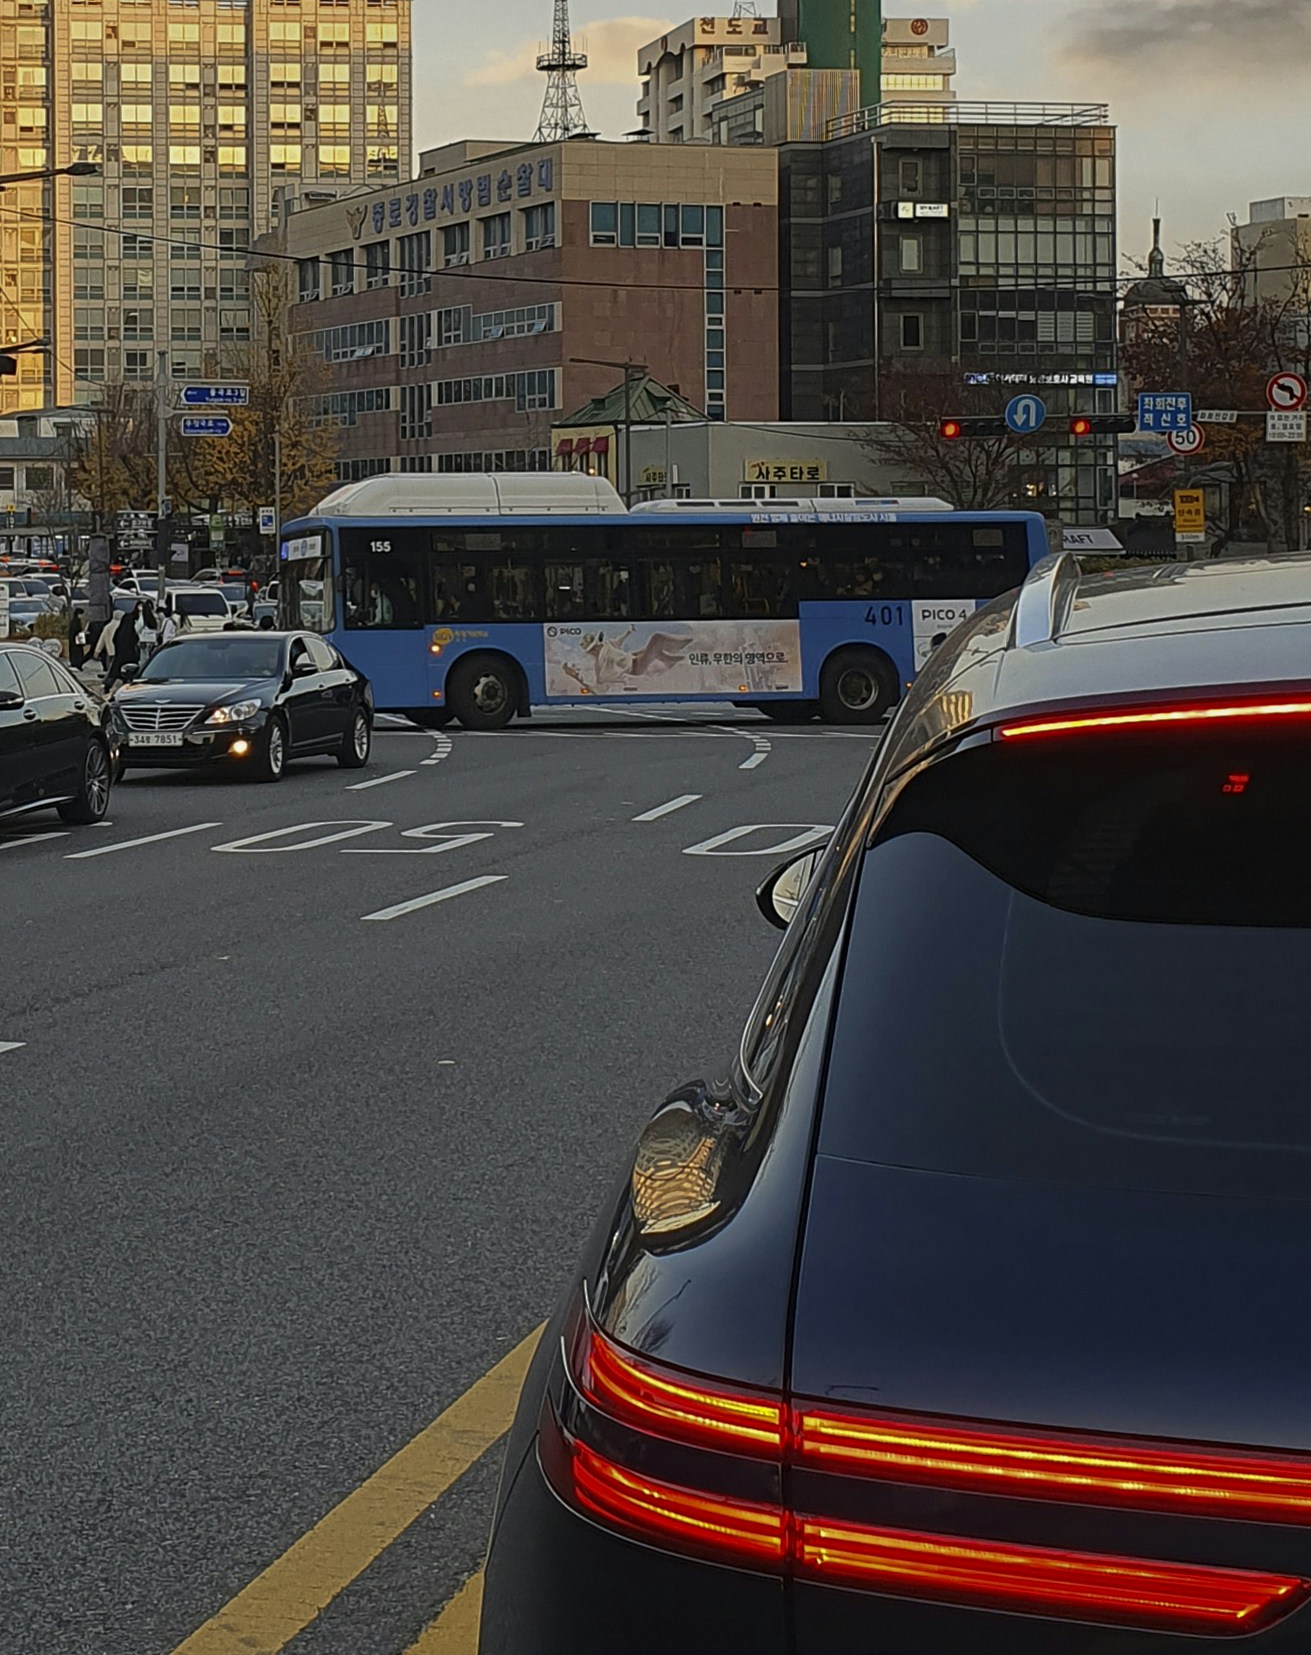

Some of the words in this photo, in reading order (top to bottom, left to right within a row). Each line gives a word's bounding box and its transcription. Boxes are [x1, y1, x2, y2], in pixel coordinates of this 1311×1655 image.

[699, 17, 769, 35] 천도교
[1143, 396, 1188, 412] 좌회전후
[1174, 429, 1197, 445] 50
[755, 465, 820, 481] 사주타로
[369, 540, 392, 553] 155
[864, 606, 904, 626] 401
[922, 609, 956, 621] PICO
[958, 609, 968, 621] 4
[556, 628, 582, 636] PICO
[689, 653, 712, 666] 인류,
[713, 653, 743, 665] 무한의
[154, 734, 177, 744] 7851
